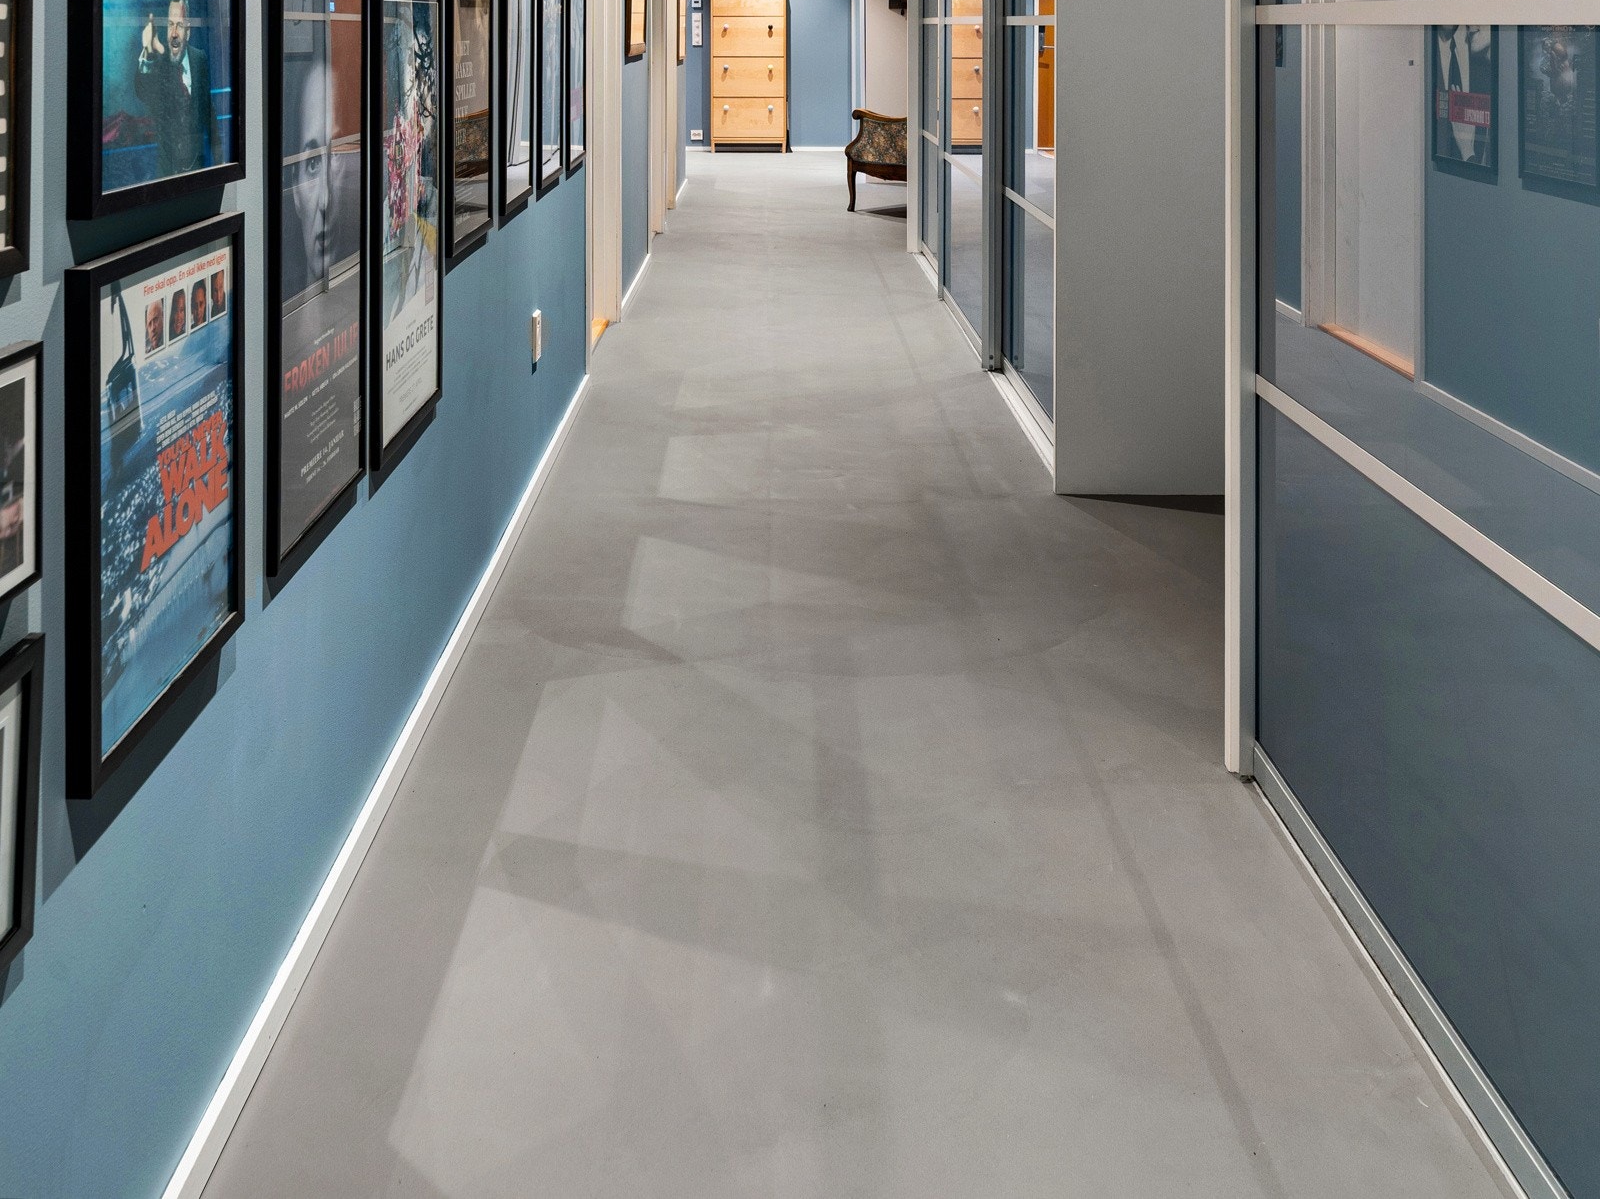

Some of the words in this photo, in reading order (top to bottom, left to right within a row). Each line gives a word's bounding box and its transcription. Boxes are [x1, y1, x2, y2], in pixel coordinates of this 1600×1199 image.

[455, 60, 473, 79] BAKER
[455, 82, 476, 101] SPILLER
[144, 284, 154, 297] Fire
[155, 278, 165, 291] skal
[166, 275, 177, 287] opp.
[186, 264, 195, 277] skal
[196, 261, 206, 272] ikke
[207, 256, 215, 267] ned
[386, 340, 404, 371] HANS
[405, 331, 414, 352] OG
[415, 314, 434, 343] GRETE
[284, 342, 330, 394] FRØKEN
[192, 410, 223, 441] NEVER
[160, 422, 227, 503] WALK
[300, 451, 322, 477] PREMIERE
[140, 456, 228, 574] ALONE
